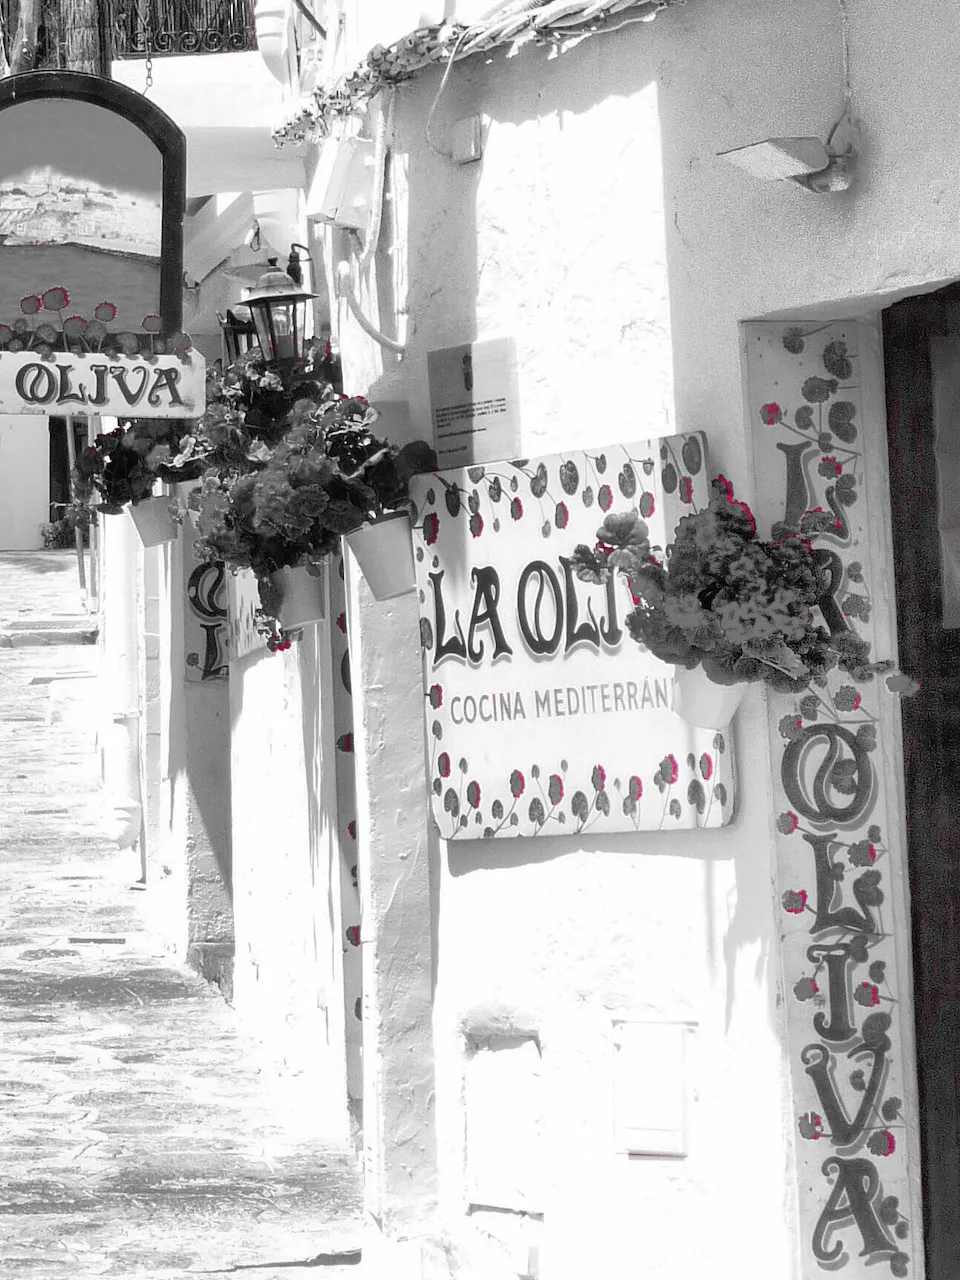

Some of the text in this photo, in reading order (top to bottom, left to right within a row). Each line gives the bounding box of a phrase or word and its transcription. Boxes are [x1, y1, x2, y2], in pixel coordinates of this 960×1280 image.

[15, 362, 185, 407] OLIVA
[428, 565, 513, 665] LA
[450, 676, 674, 725] COCINA MEDITERRÁN
[781, 723, 900, 1263] OLIVA
